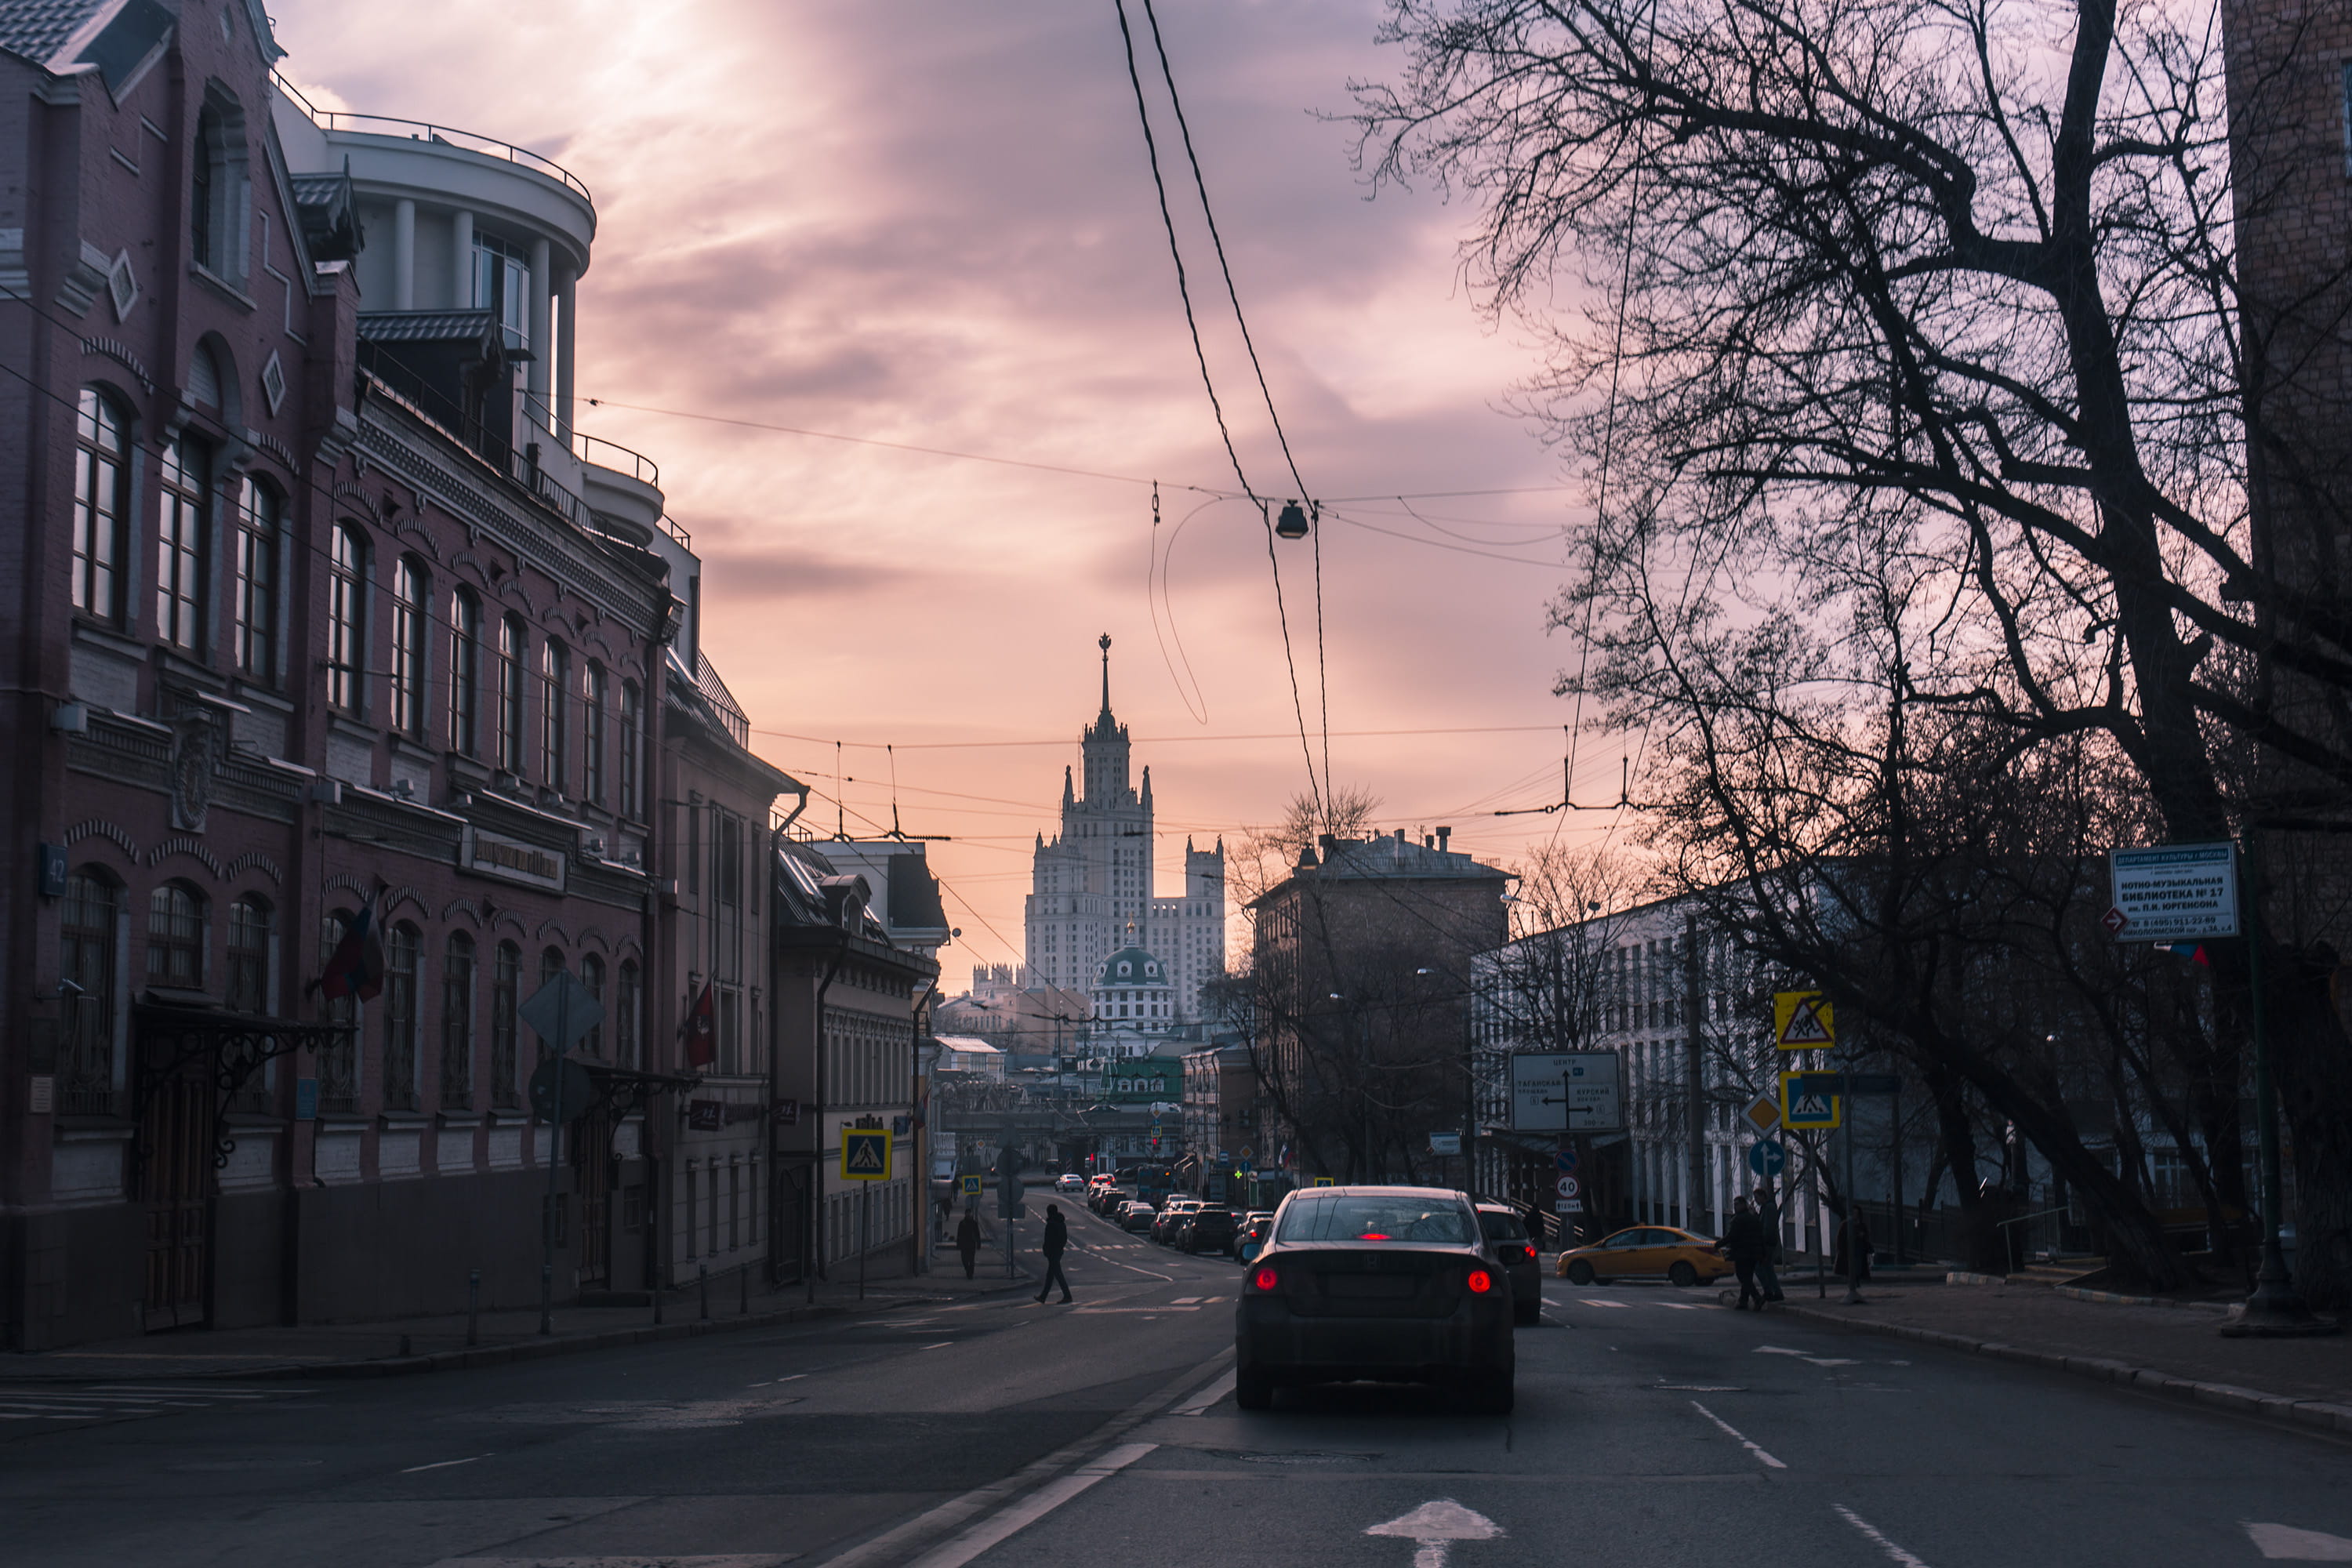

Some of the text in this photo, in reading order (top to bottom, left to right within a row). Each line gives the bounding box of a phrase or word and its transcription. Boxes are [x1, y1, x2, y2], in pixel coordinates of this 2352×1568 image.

[2117, 855, 2160, 865] ДЕПАРТАМЕНТ
[2161, 852, 2194, 862] КУЛЬТУРЫ
[49, 858, 64, 883] 42
[2122, 877, 2223, 889] НОТНО-МУЗЫКАЛЬНАЯ
[2122, 890, 2193, 902] БИБЛИОТЕКА
[2210, 887, 2224, 898] 17
[2143, 903, 2160, 912] П.И.
[2162, 901, 2219, 910] ЮРГЕНСОНА
[2123, 927, 2185, 936] НИКОЛОЯМСКОЙ
[1577, 1087, 1610, 1095] КУРСКИЙ
[1559, 1181, 1575, 1192] 40
